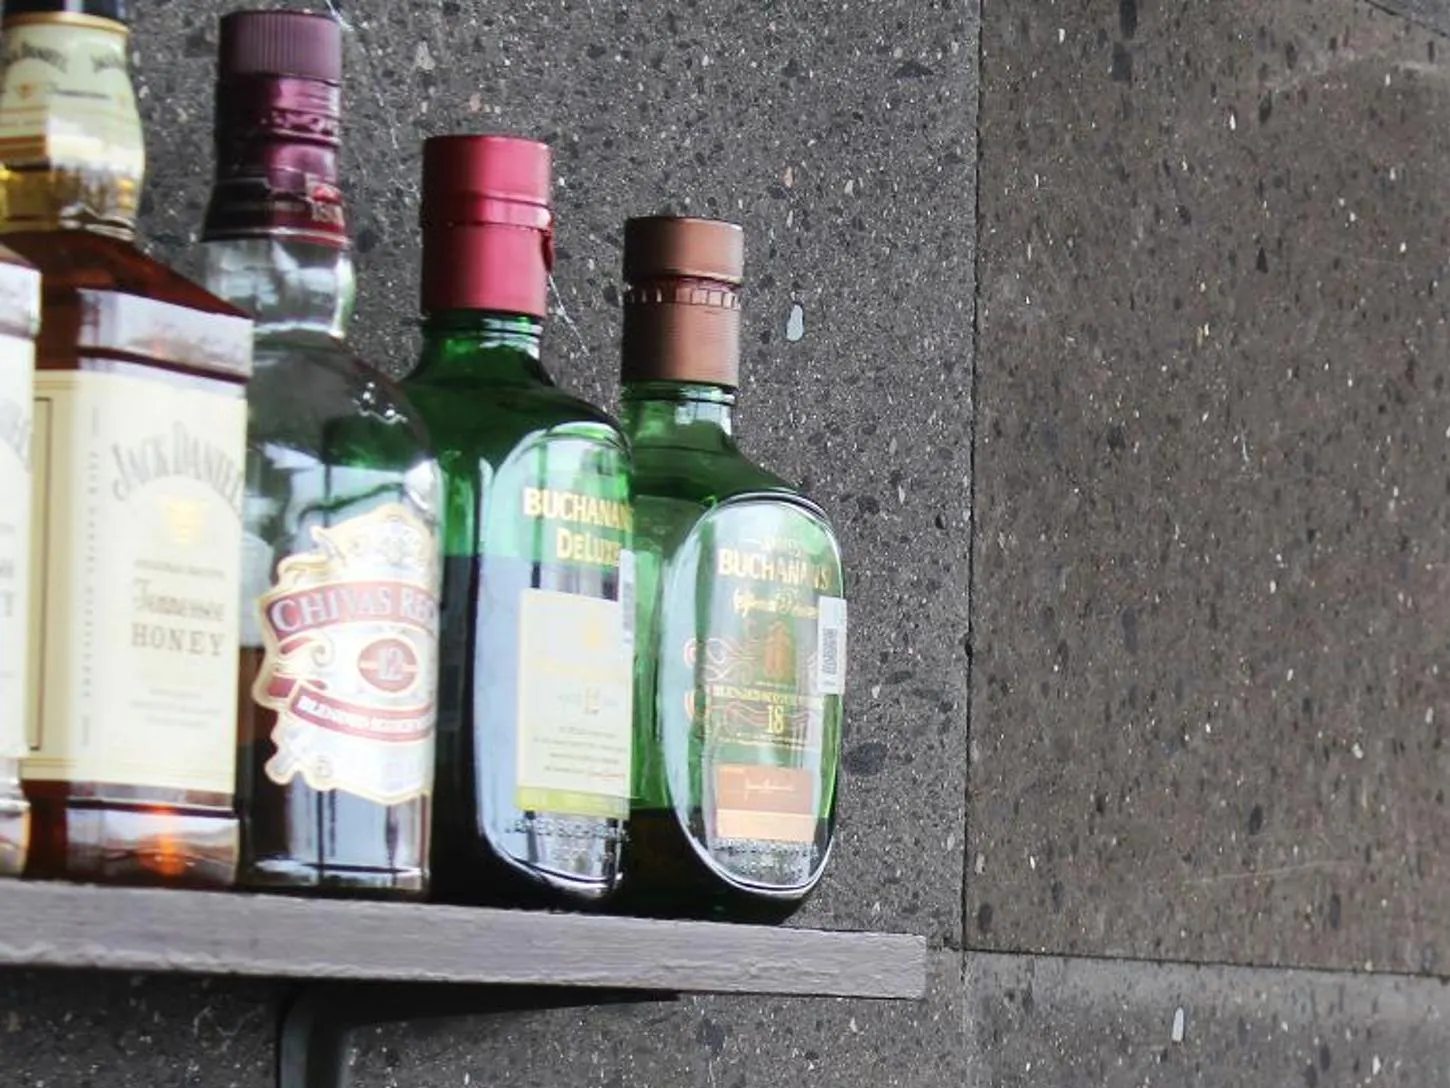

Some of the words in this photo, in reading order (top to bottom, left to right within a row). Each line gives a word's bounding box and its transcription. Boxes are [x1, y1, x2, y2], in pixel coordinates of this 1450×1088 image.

[271, 587, 395, 632] CHIVAS
[131, 622, 226, 658] HONEY
[767, 704, 785, 735] 18
